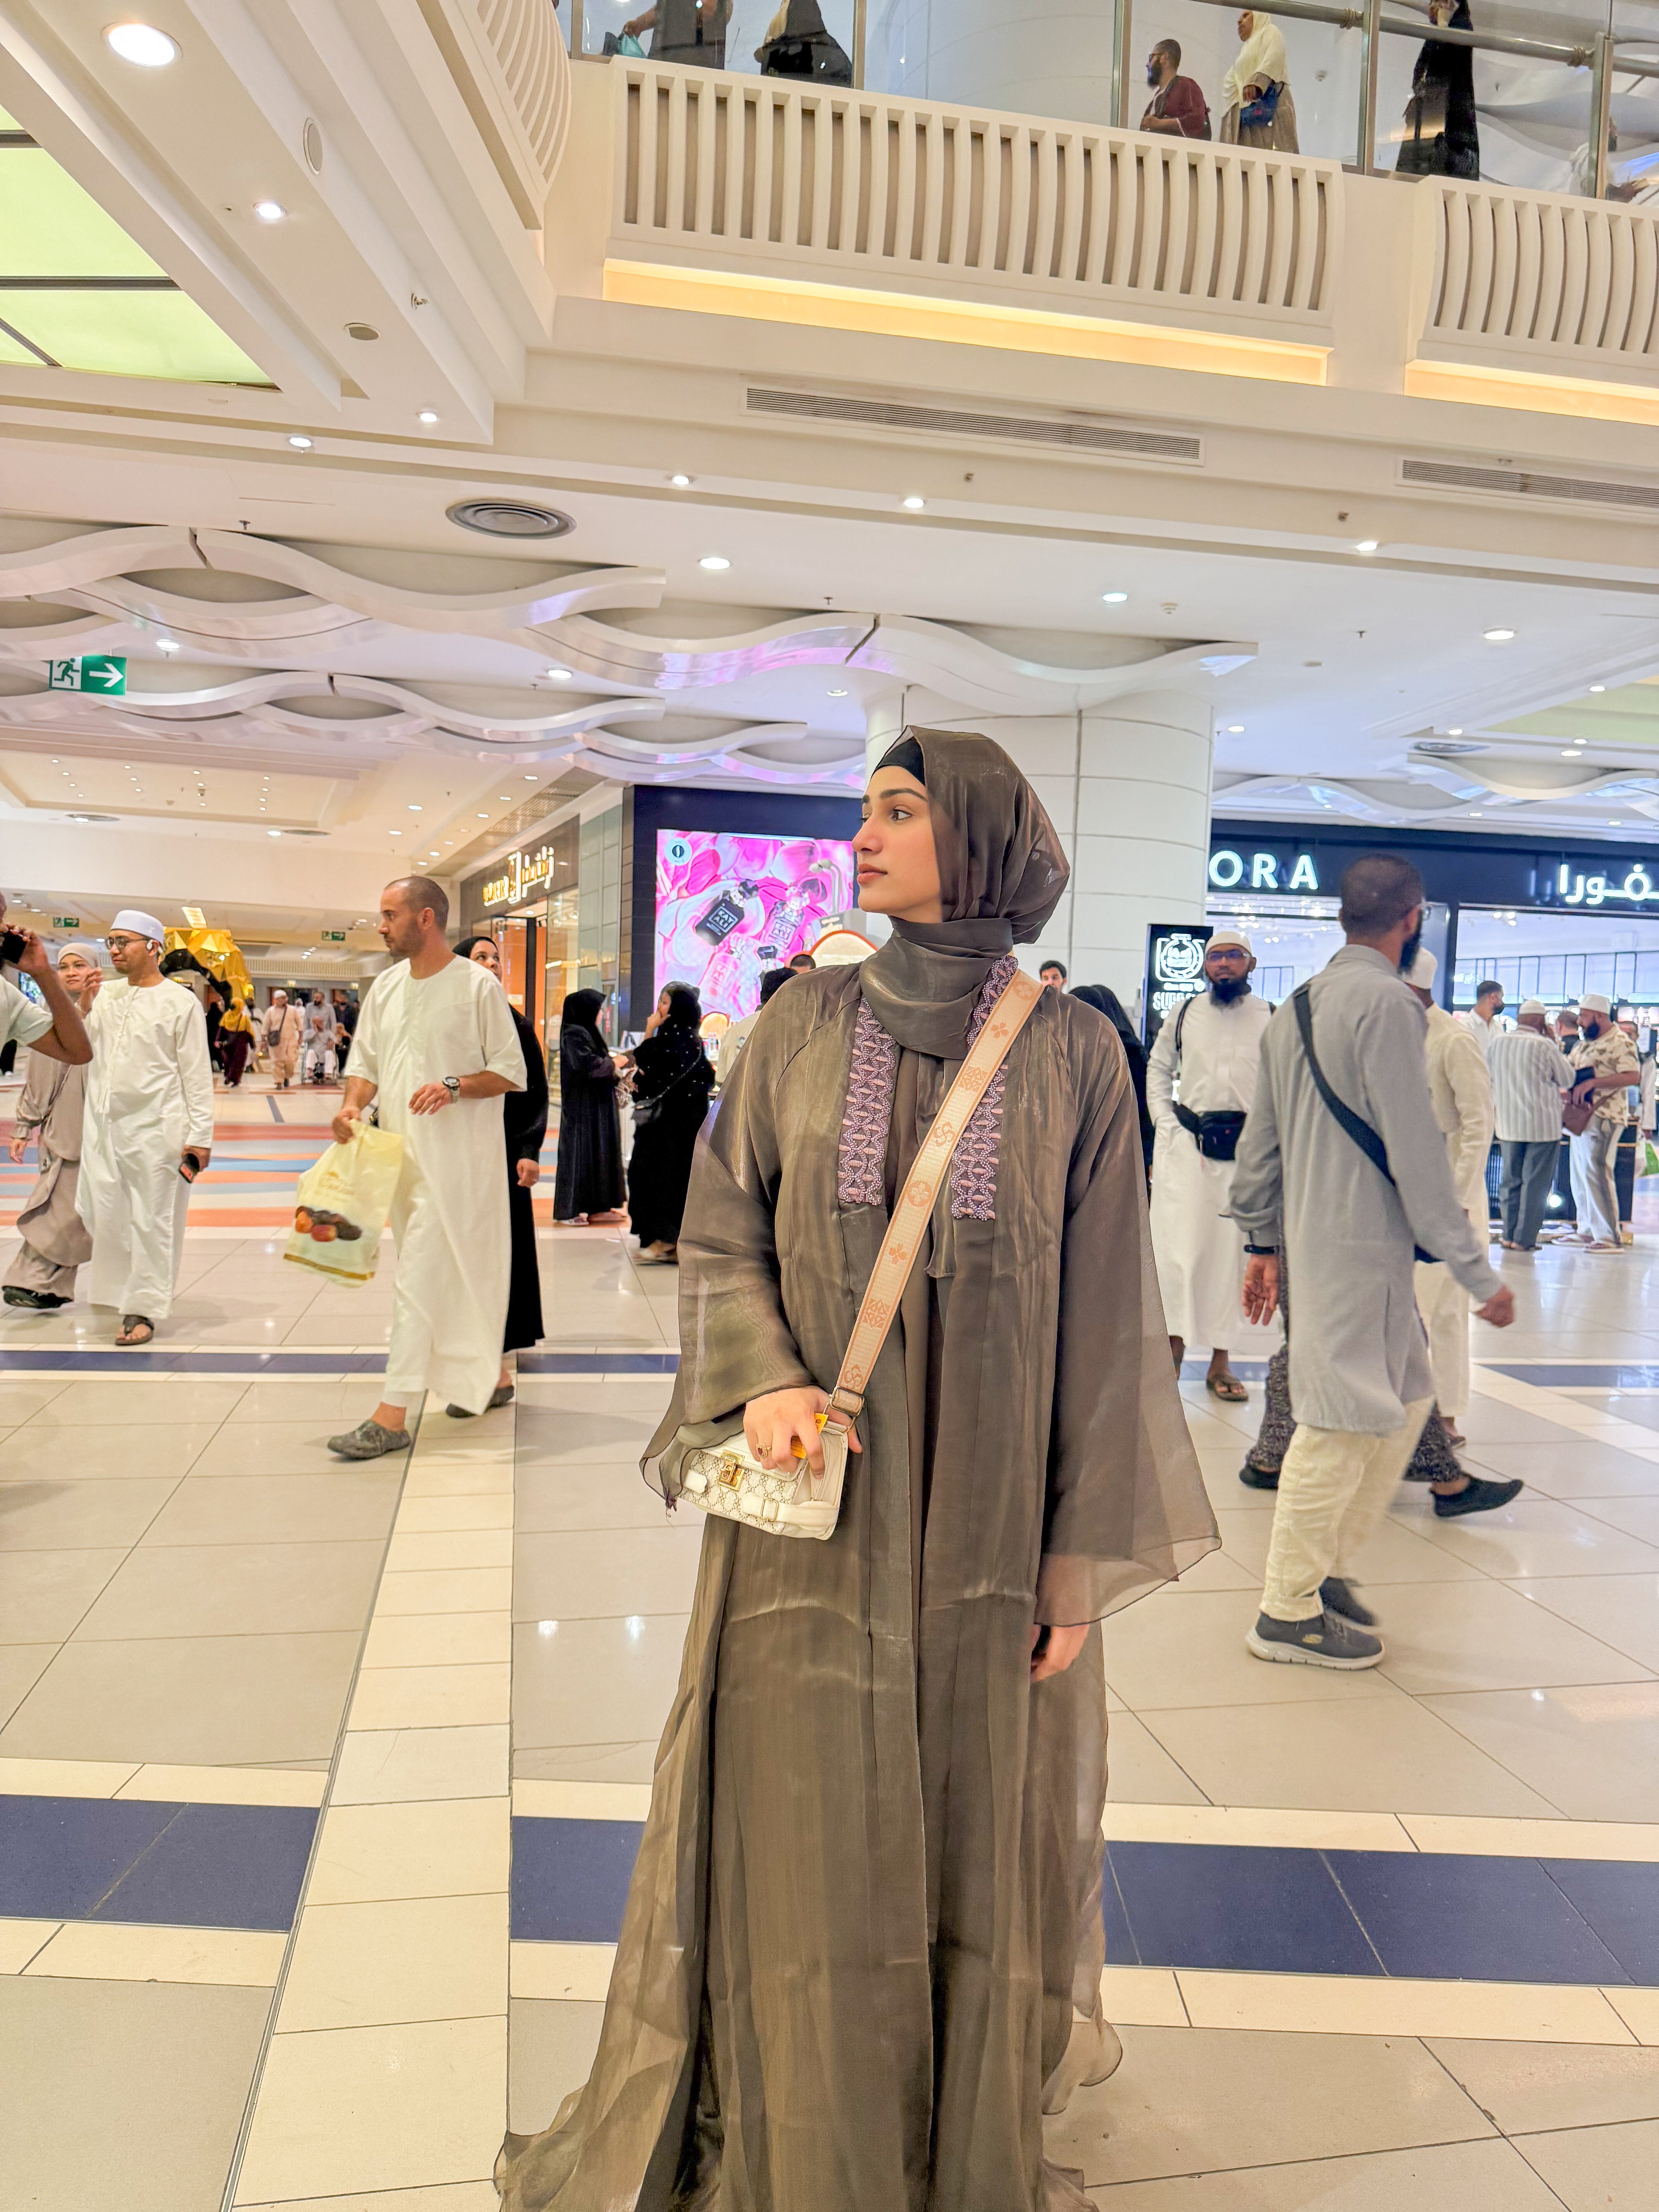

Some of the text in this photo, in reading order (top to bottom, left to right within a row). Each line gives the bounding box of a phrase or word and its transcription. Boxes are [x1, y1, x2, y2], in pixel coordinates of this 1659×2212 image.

[1559, 864, 1659, 904] فورا
[713, 915, 728, 928] ALI
[717, 909, 735, 922] KAY
